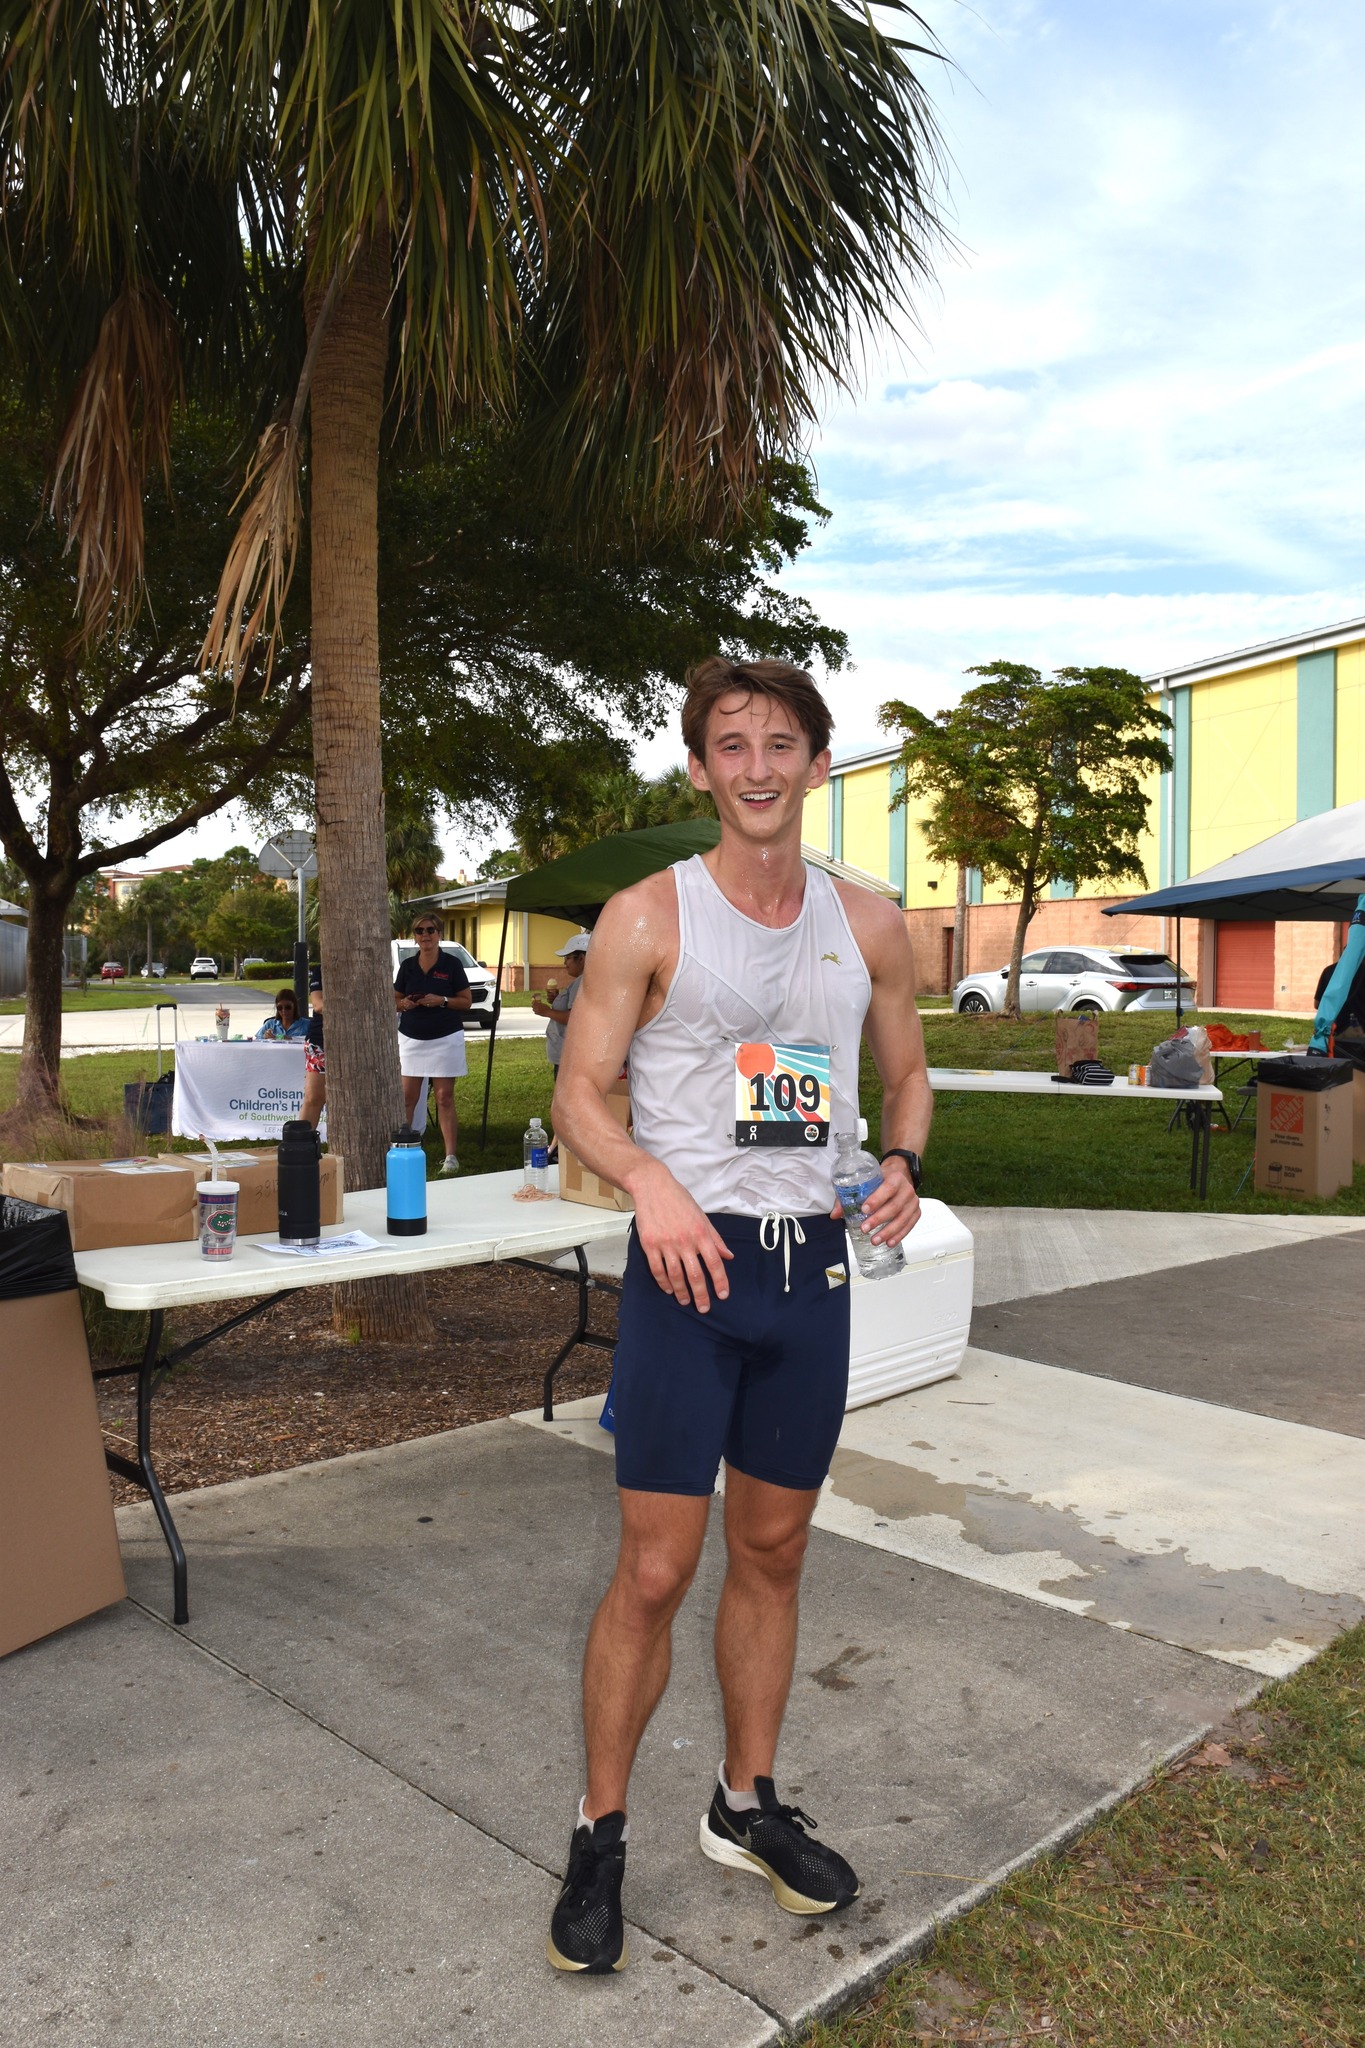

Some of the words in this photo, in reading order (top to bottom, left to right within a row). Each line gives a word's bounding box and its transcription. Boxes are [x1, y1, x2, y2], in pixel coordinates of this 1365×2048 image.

[258, 1087, 305, 1099] Golisan
[750, 1073, 820, 1112] 109
[1275, 1098, 1288, 1112] THE
[239, 1112, 248, 1120] of
[250, 1112, 297, 1122] Southwest
[1271, 1095, 1304, 1130] HOME
[1283, 1109, 1304, 1132] DEPOT
[1284, 1165, 1302, 1173] TRASH
